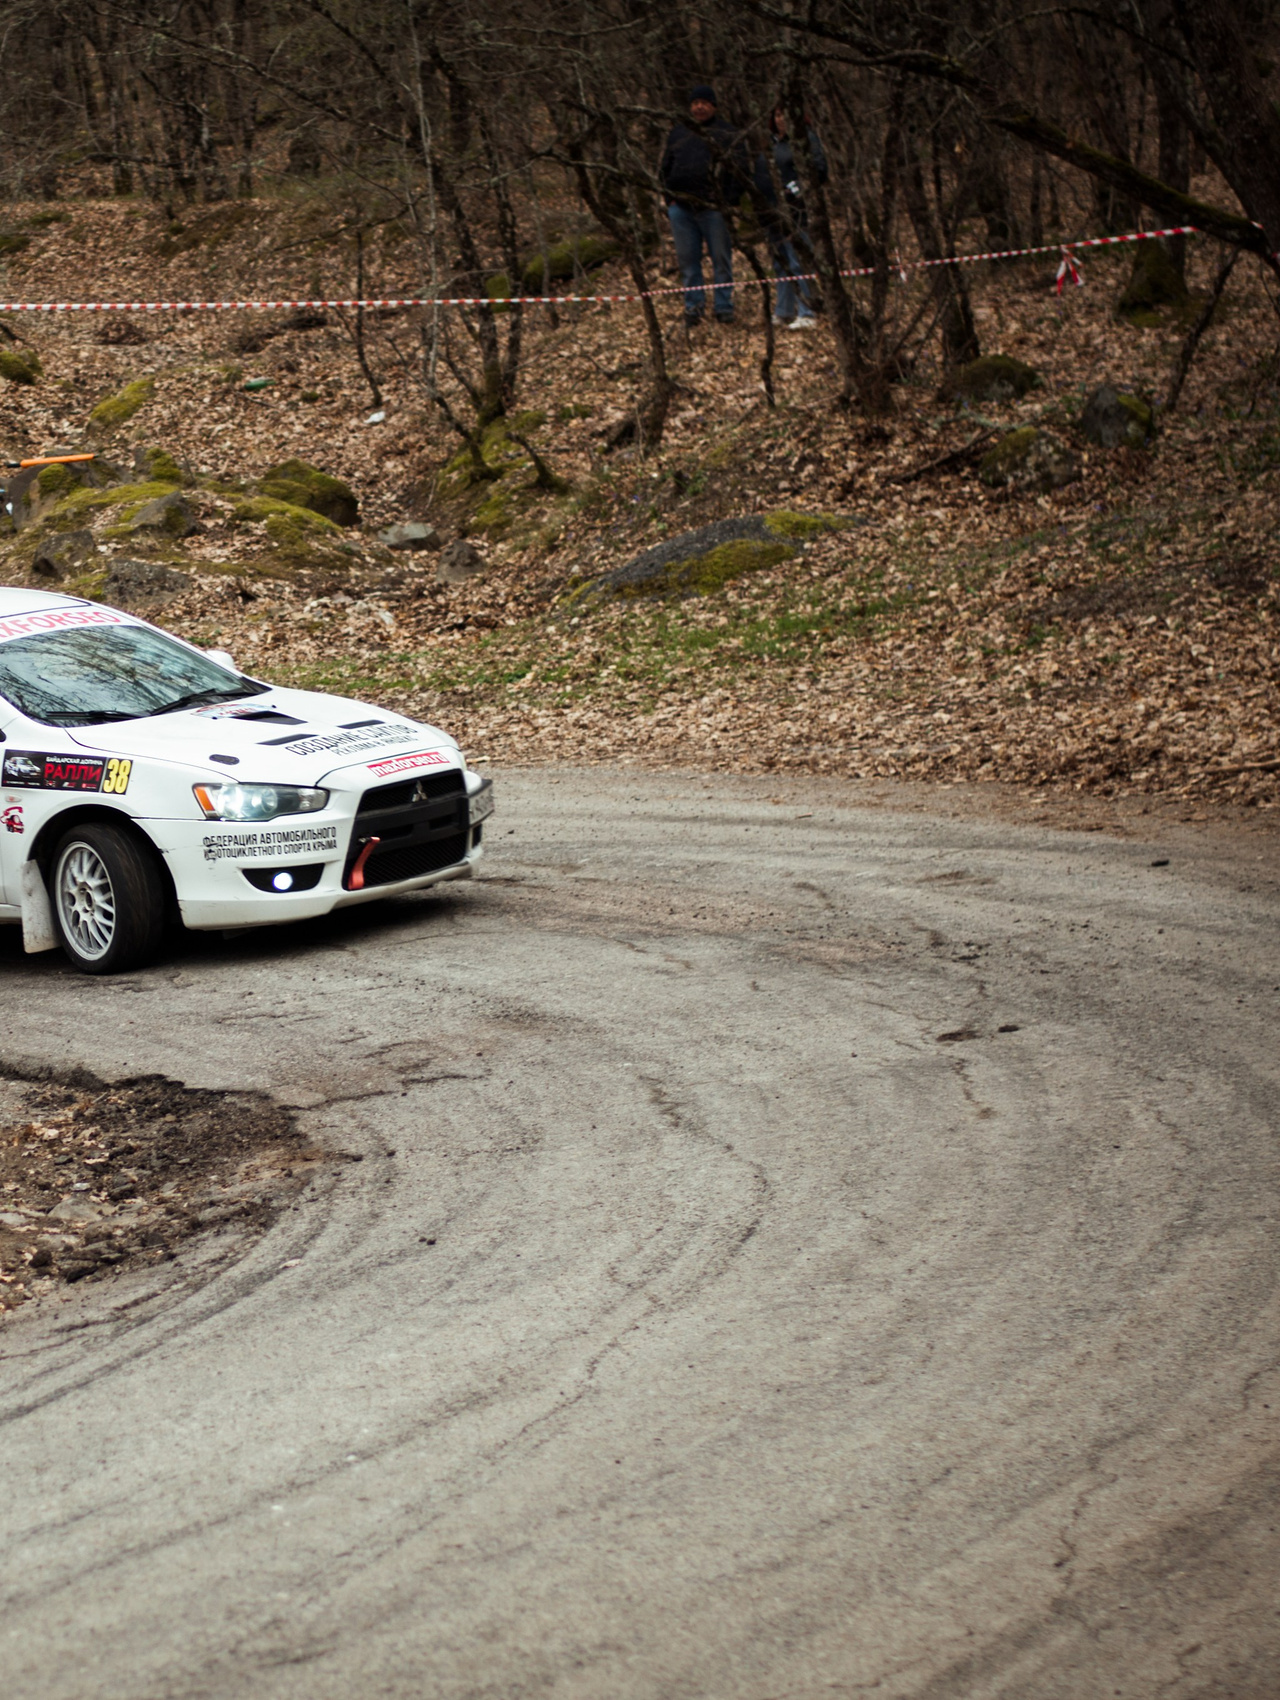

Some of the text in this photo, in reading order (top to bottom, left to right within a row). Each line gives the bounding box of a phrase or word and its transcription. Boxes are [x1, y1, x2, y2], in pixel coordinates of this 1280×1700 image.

[285, 732, 369, 756] СОЗДАНИЕ
[44, 763, 102, 781] РАЛЛИ
[103, 758, 132, 794] 38
[371, 753, 449, 777] maxforseo.ru
[203, 826, 337, 848] ФЕДЕРАЦИЯ АВТОМОБИЛЬНОГО
[209, 844, 282, 860] ОТОЦИКЛЕТНОГО
[283, 842, 311, 854] СПОРТА
[312, 839, 338, 851] КРЫМА
